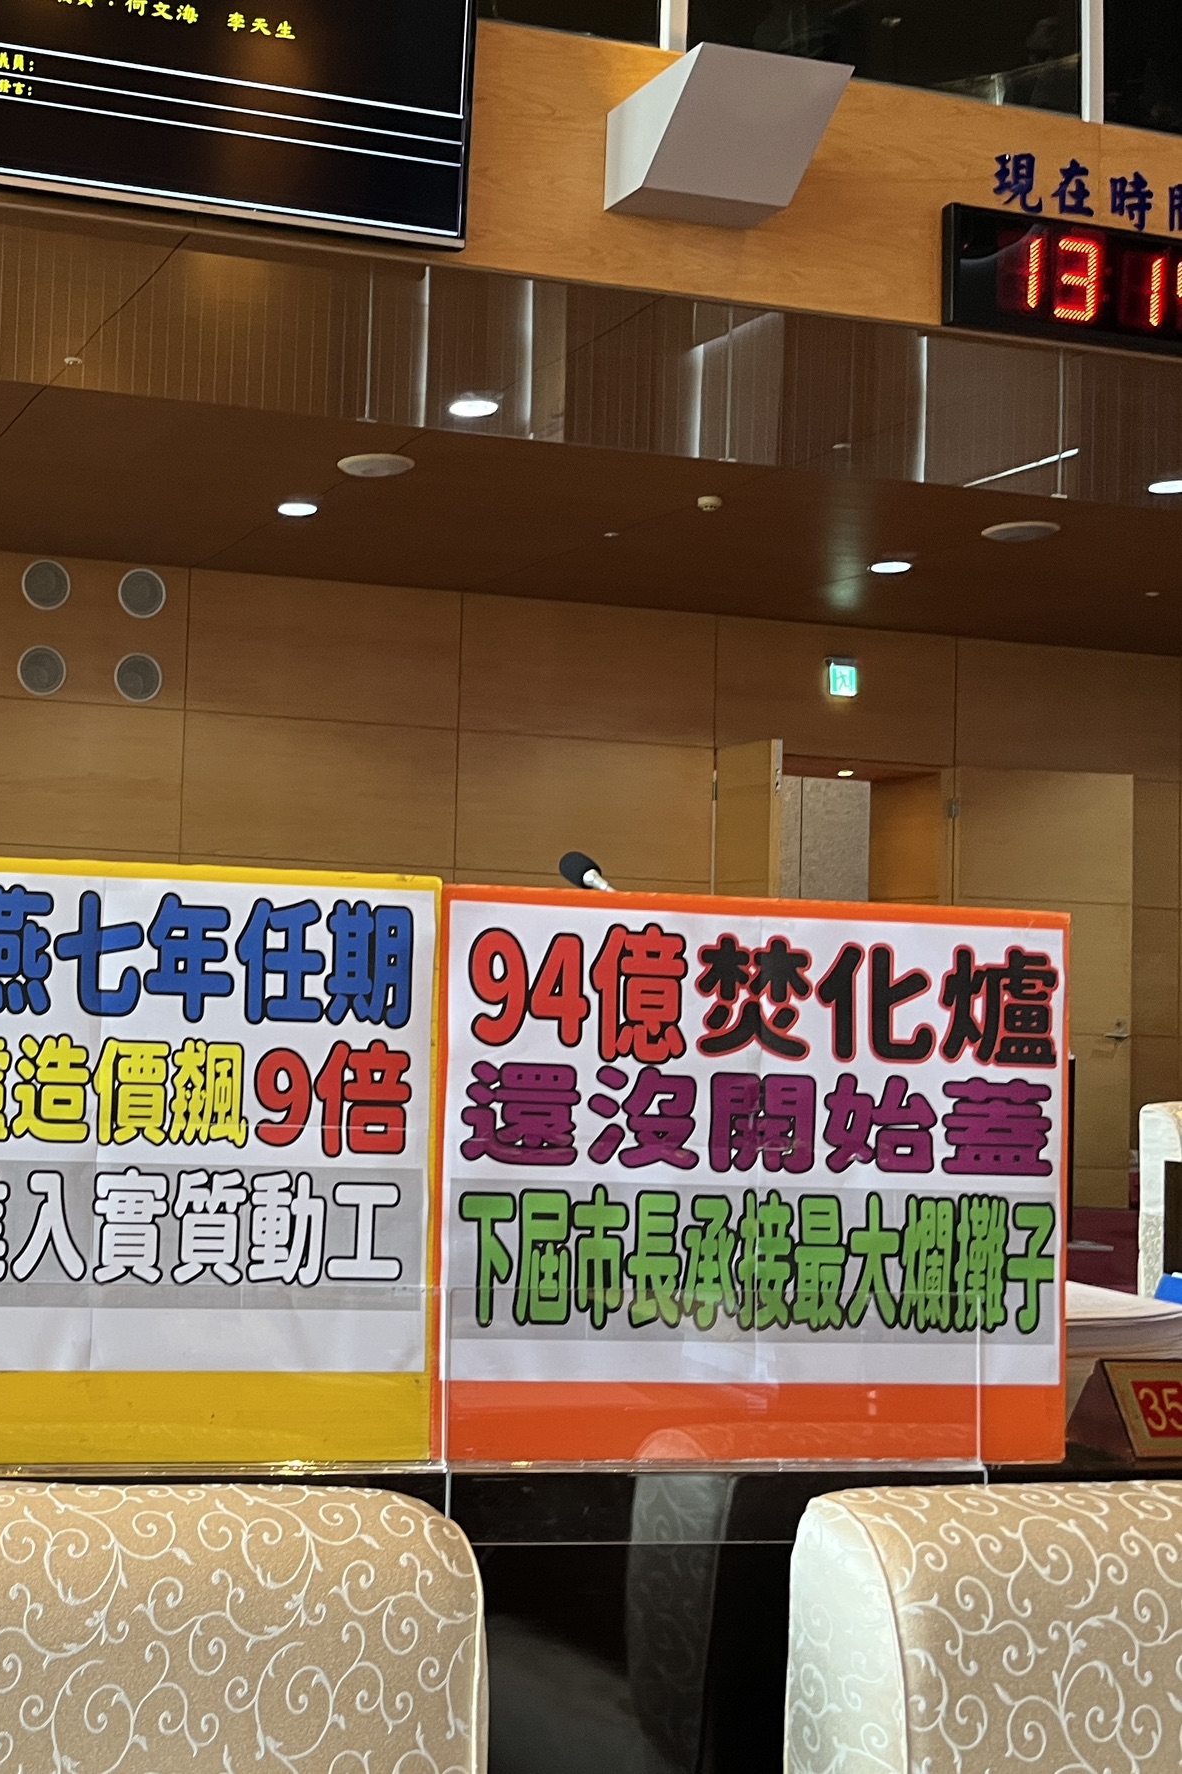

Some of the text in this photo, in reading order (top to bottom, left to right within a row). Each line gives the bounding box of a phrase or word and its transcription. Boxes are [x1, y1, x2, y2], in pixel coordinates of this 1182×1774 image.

[226, 11, 296, 40] 李天生
[1026, 237, 1182, 328] 13 1
[468, 922, 1060, 1069] 94億焚化爐
[460, 1060, 1054, 1178] 還沒開始蓋
[458, 1184, 1057, 1335] 下屆市長承接最大爛攤子
[1138, 1387, 1182, 1432] 35
